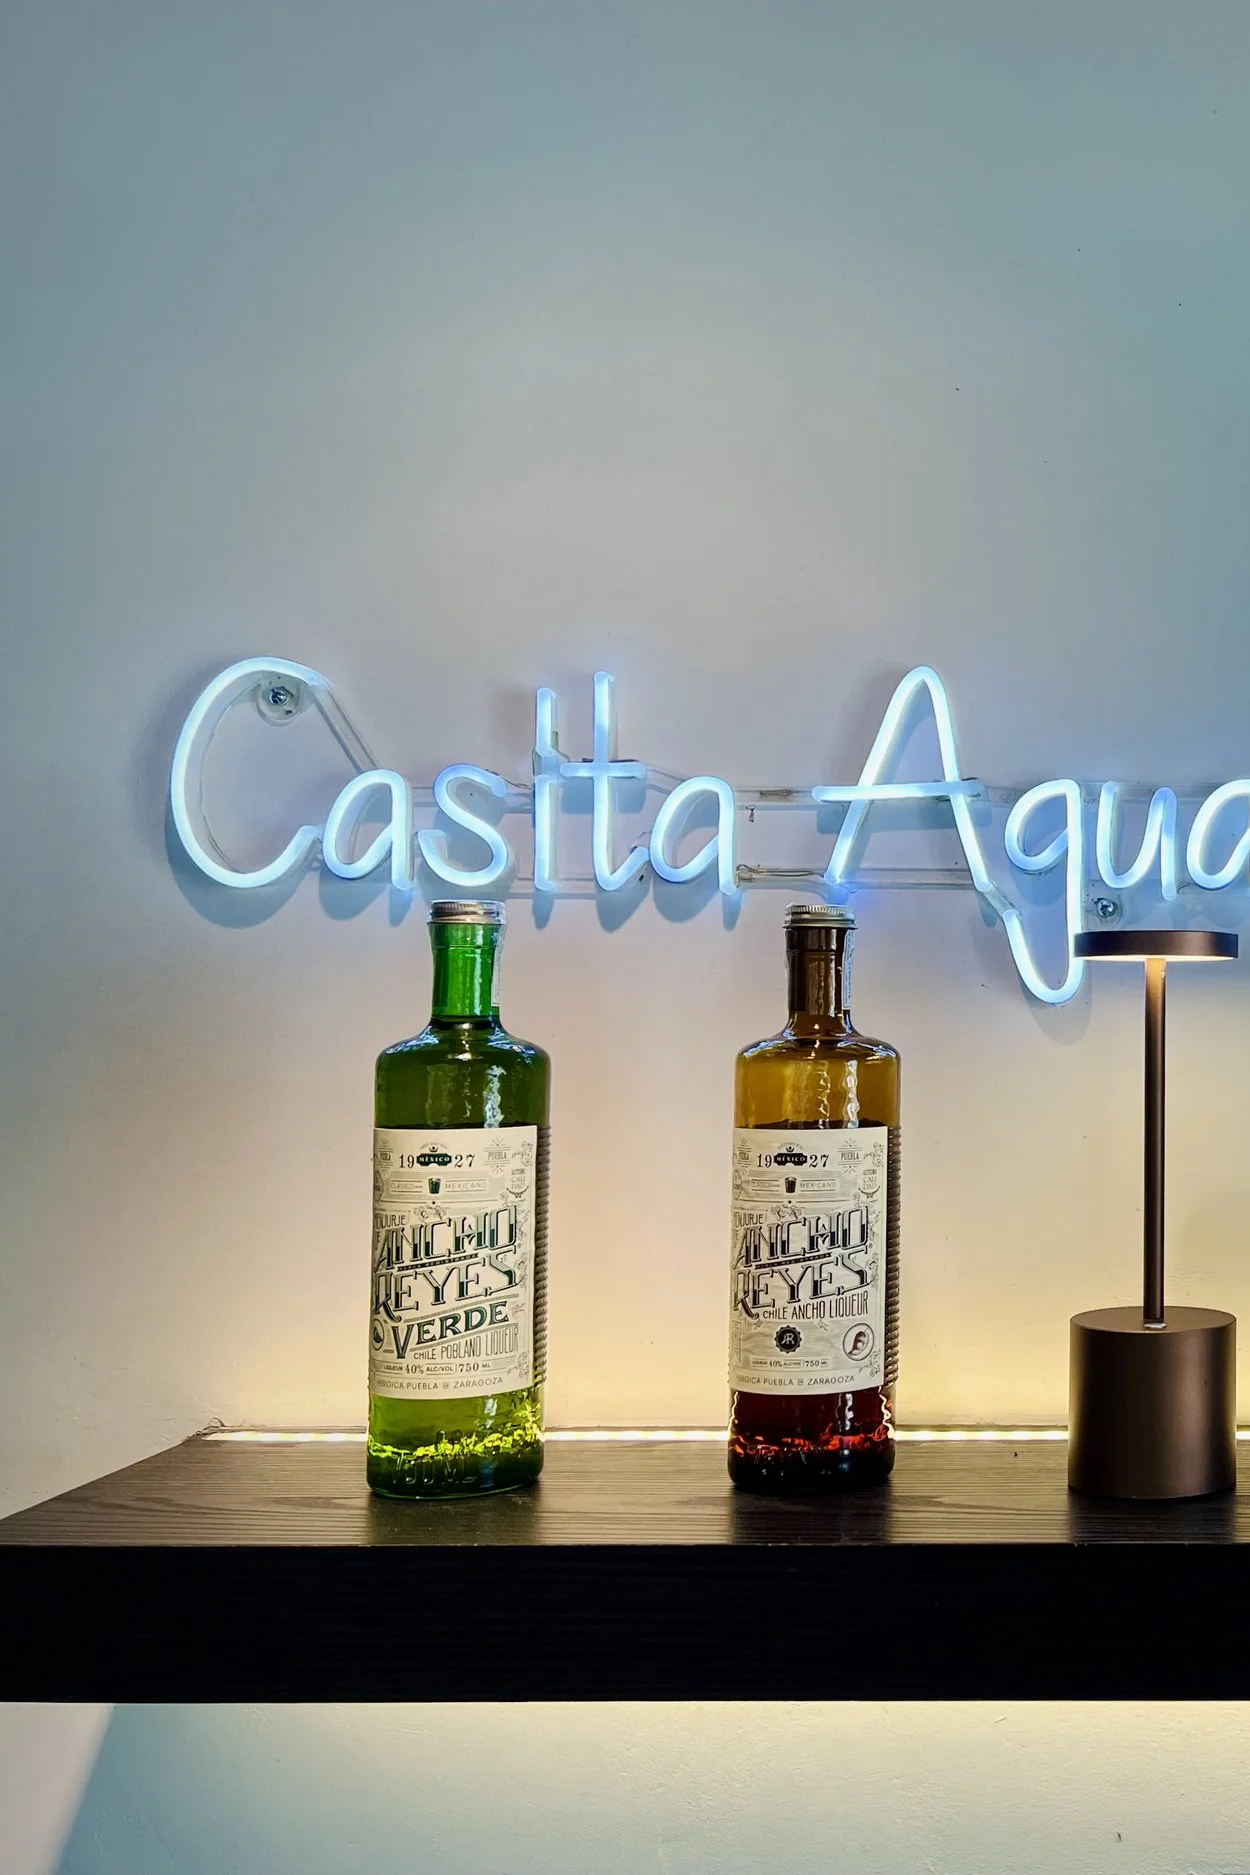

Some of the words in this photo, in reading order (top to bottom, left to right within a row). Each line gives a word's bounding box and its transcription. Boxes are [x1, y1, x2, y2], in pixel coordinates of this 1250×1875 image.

[170, 655, 742, 892] Casita
[375, 1205, 517, 1272] ANCHO
[734, 1205, 869, 1271] ANCHO
[373, 1245, 523, 1323] REYES
[733, 1244, 875, 1320] REYES
[762, 1307, 788, 1320] CHILE
[791, 1300, 825, 1320] ANCHO
[829, 1290, 869, 1319] LIQUEUR
[391, 1300, 509, 1360] VERDE
[413, 1349, 437, 1361] CHILE
[440, 1335, 482, 1360] POBLANO
[485, 1326, 520, 1357] LIQUEUR
[405, 1363, 424, 1375] 40%
[459, 1362, 479, 1373] 750
[406, 1381, 439, 1390] PUEBLA
[453, 1376, 503, 1389] ZARAGOZA
[763, 1377, 794, 1386] PUEBLA
[807, 1375, 855, 1386] ZARAGOZA
